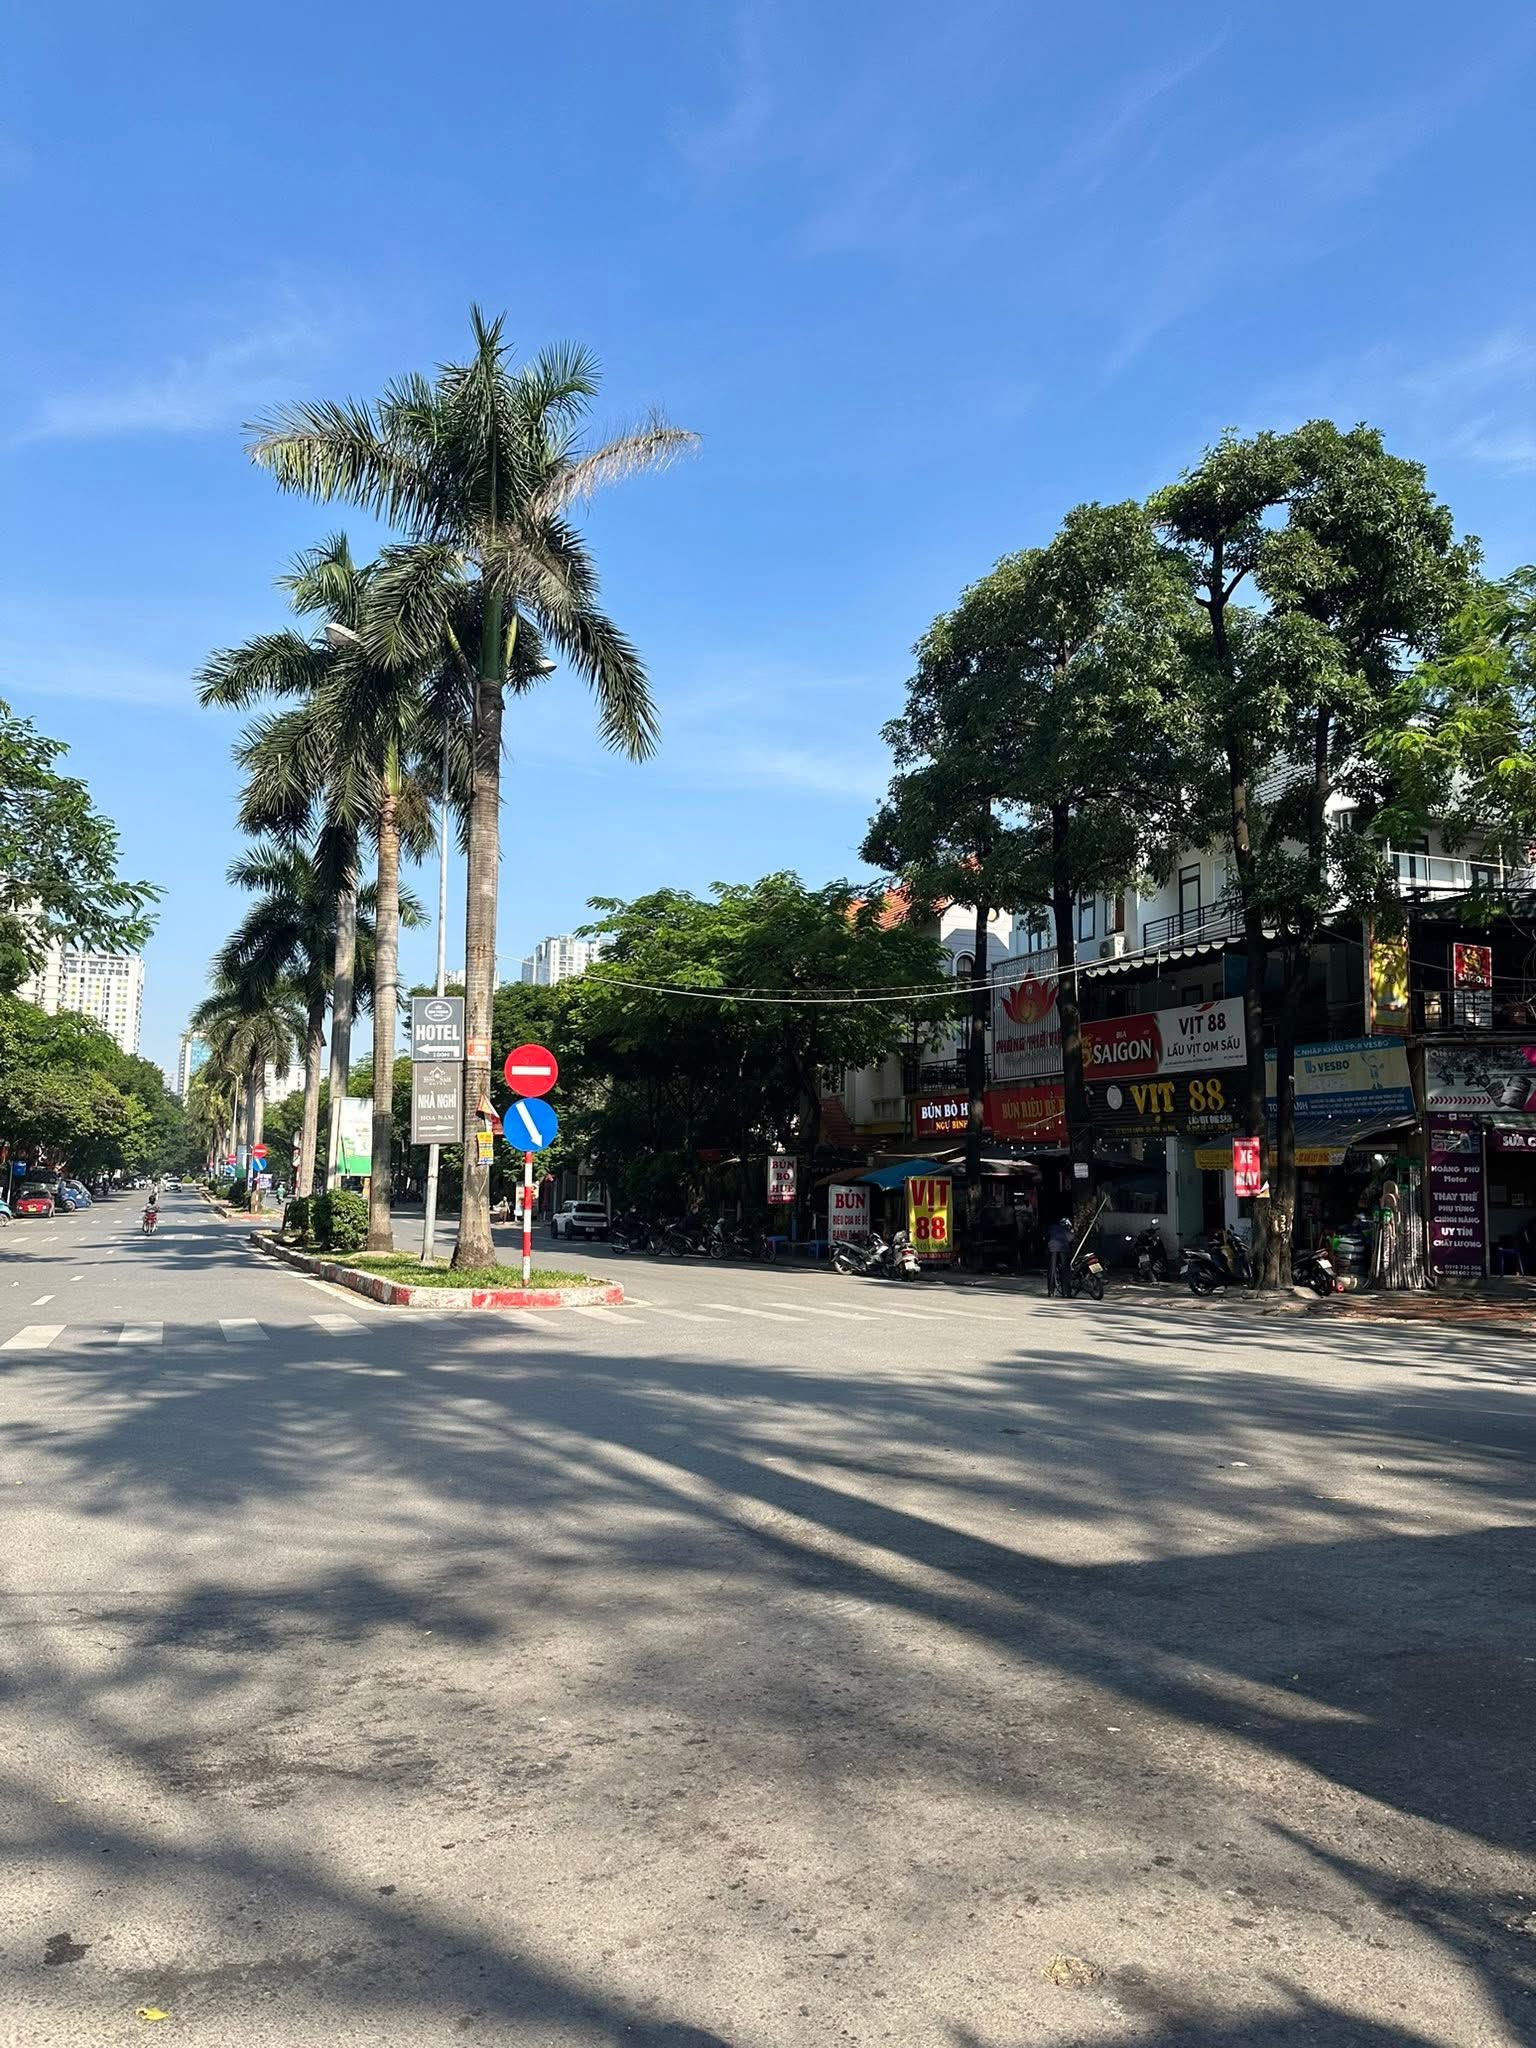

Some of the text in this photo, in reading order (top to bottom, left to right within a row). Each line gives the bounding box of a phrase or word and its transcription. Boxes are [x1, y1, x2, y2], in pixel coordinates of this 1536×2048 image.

[416, 1024, 460, 1040] HOTEL
[1179, 1013, 1226, 1040] VỊT 88
[1092, 1037, 1152, 1064] SAIGON
[1186, 1043, 1201, 1058] VỊT
[1203, 1041, 1219, 1053] OM
[1318, 1060, 1350, 1073] VESBO
[418, 1090, 435, 1109] NHÀ
[1188, 1078, 1226, 1112] 88
[921, 1101, 942, 1119] BÚN
[944, 1099, 958, 1118] BÒ
[772, 1158, 794, 1169] BÚN
[1240, 1149, 1253, 1164] XE
[835, 1189, 865, 1209] BÚN
[911, 1180, 951, 1213] VỊT
[1432, 1192, 1458, 1201] THAY
[916, 1216, 946, 1240] 88
[1441, 1227, 1455, 1236] UY
